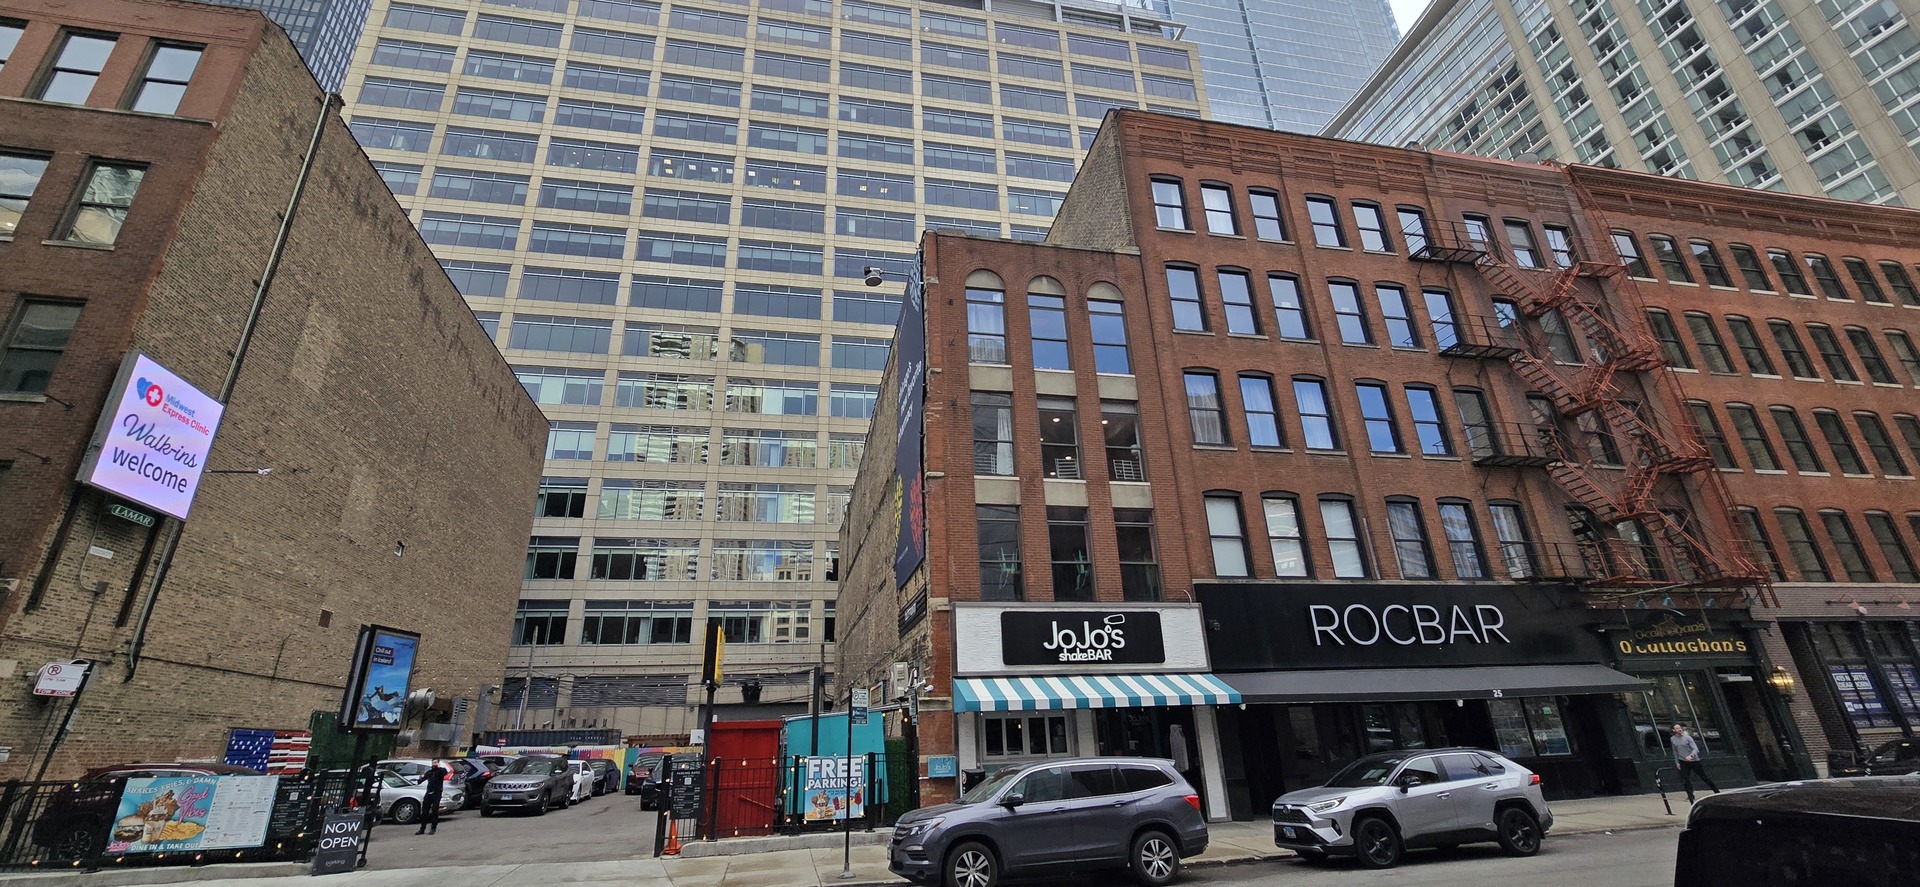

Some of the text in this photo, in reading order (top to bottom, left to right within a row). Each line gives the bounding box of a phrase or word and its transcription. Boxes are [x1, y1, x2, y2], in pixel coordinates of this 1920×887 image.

[165, 394, 196, 418] Midwest
[162, 403, 210, 436] Express Clinic
[123, 414, 198, 468] Walk-ins
[112, 446, 187, 493] welcome
[115, 506, 152, 525] LAMAR
[1309, 603, 1511, 646] ROCBAR
[1043, 620, 1125, 649] JoJo's
[1059, 648, 1112, 661] shakeBAR
[1493, 689, 1503, 698] 25
[808, 757, 862, 779] FREE
[126, 786, 158, 794] SHAKES
[161, 779, 185, 791] FRIES,
[194, 777, 218, 785] DAMN
[808, 777, 861, 789] PARKING!
[178, 785, 209, 804] Good
[179, 801, 207, 822] Vibes
[324, 821, 361, 835] NOW
[131, 844, 148, 852] DINE
[320, 836, 359, 850] OPEN
